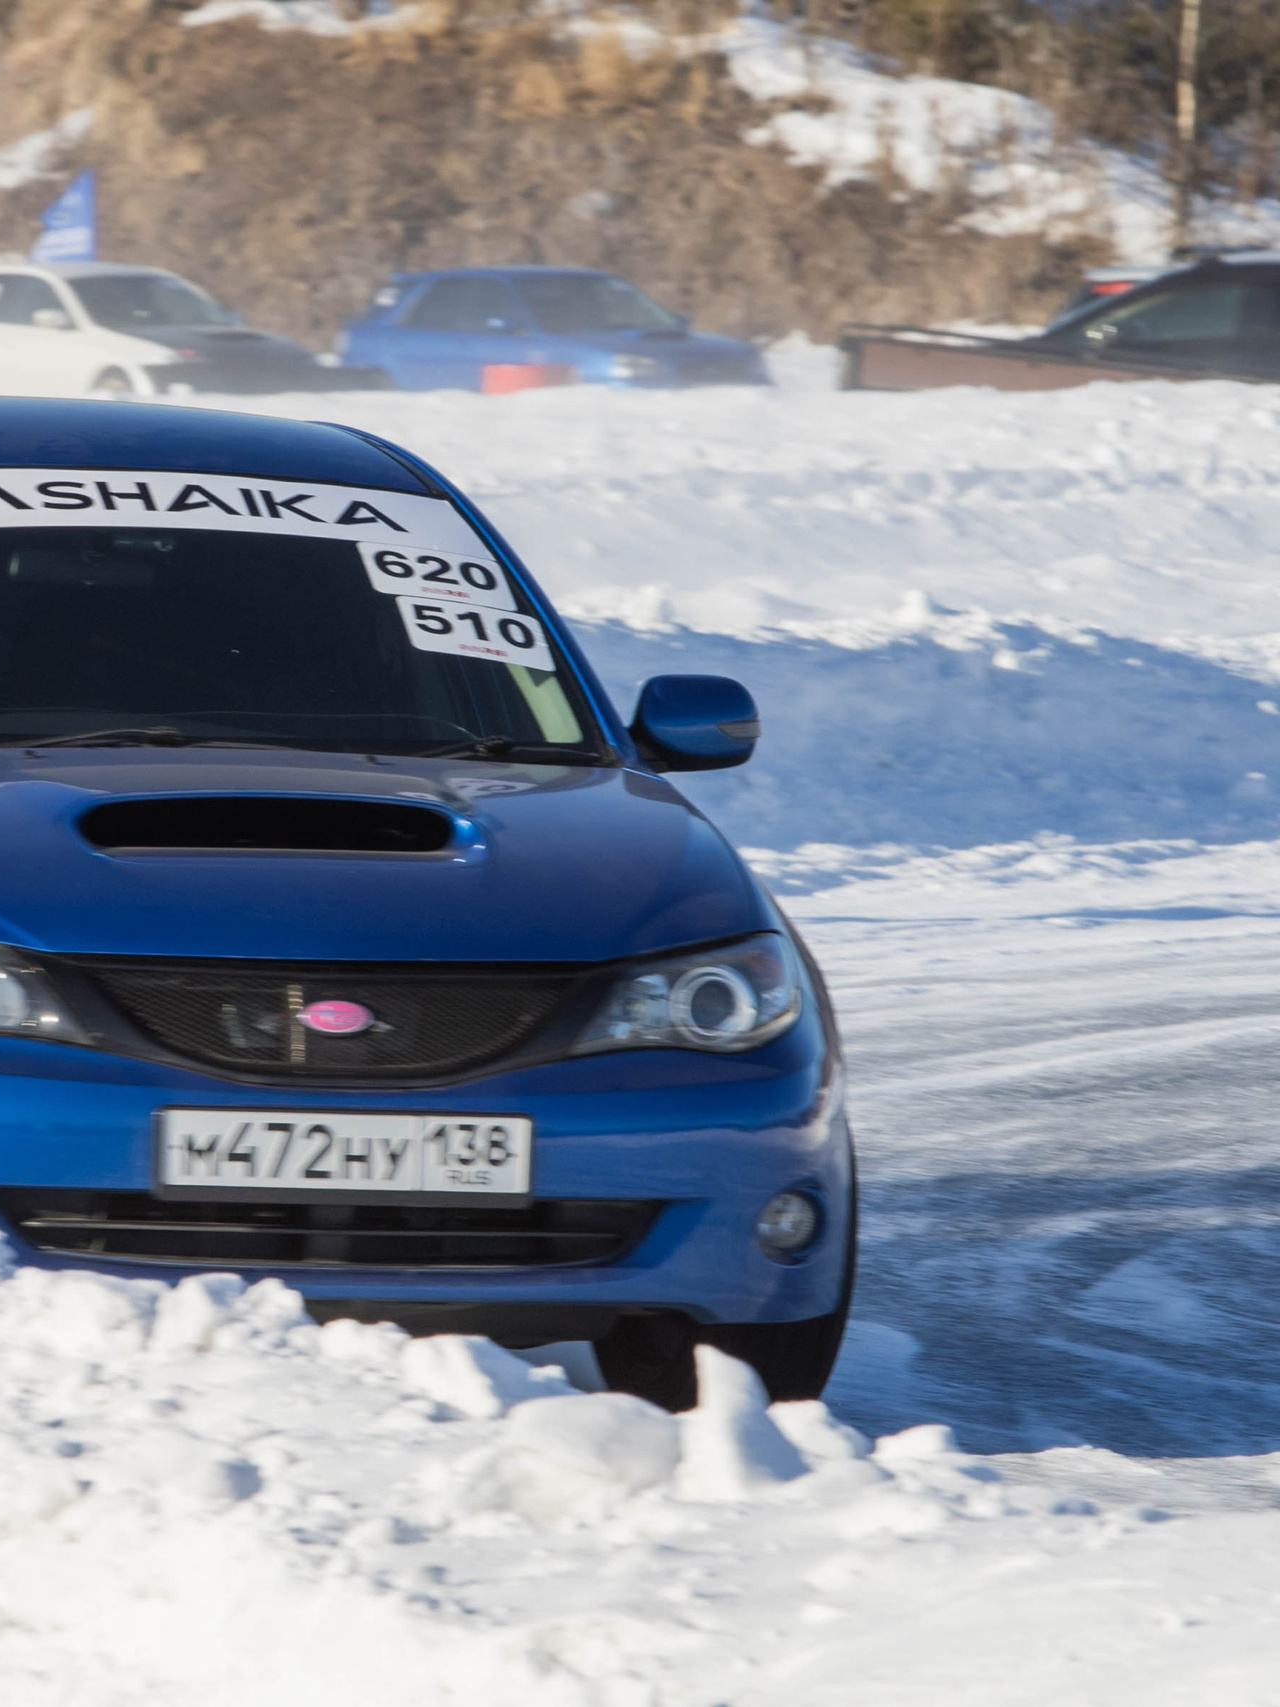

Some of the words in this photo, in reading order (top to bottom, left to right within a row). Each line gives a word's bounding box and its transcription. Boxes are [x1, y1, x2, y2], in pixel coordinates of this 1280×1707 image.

[374, 550, 497, 590] 620
[412, 603, 535, 649] 510
[424, 1123, 508, 1167] 138
